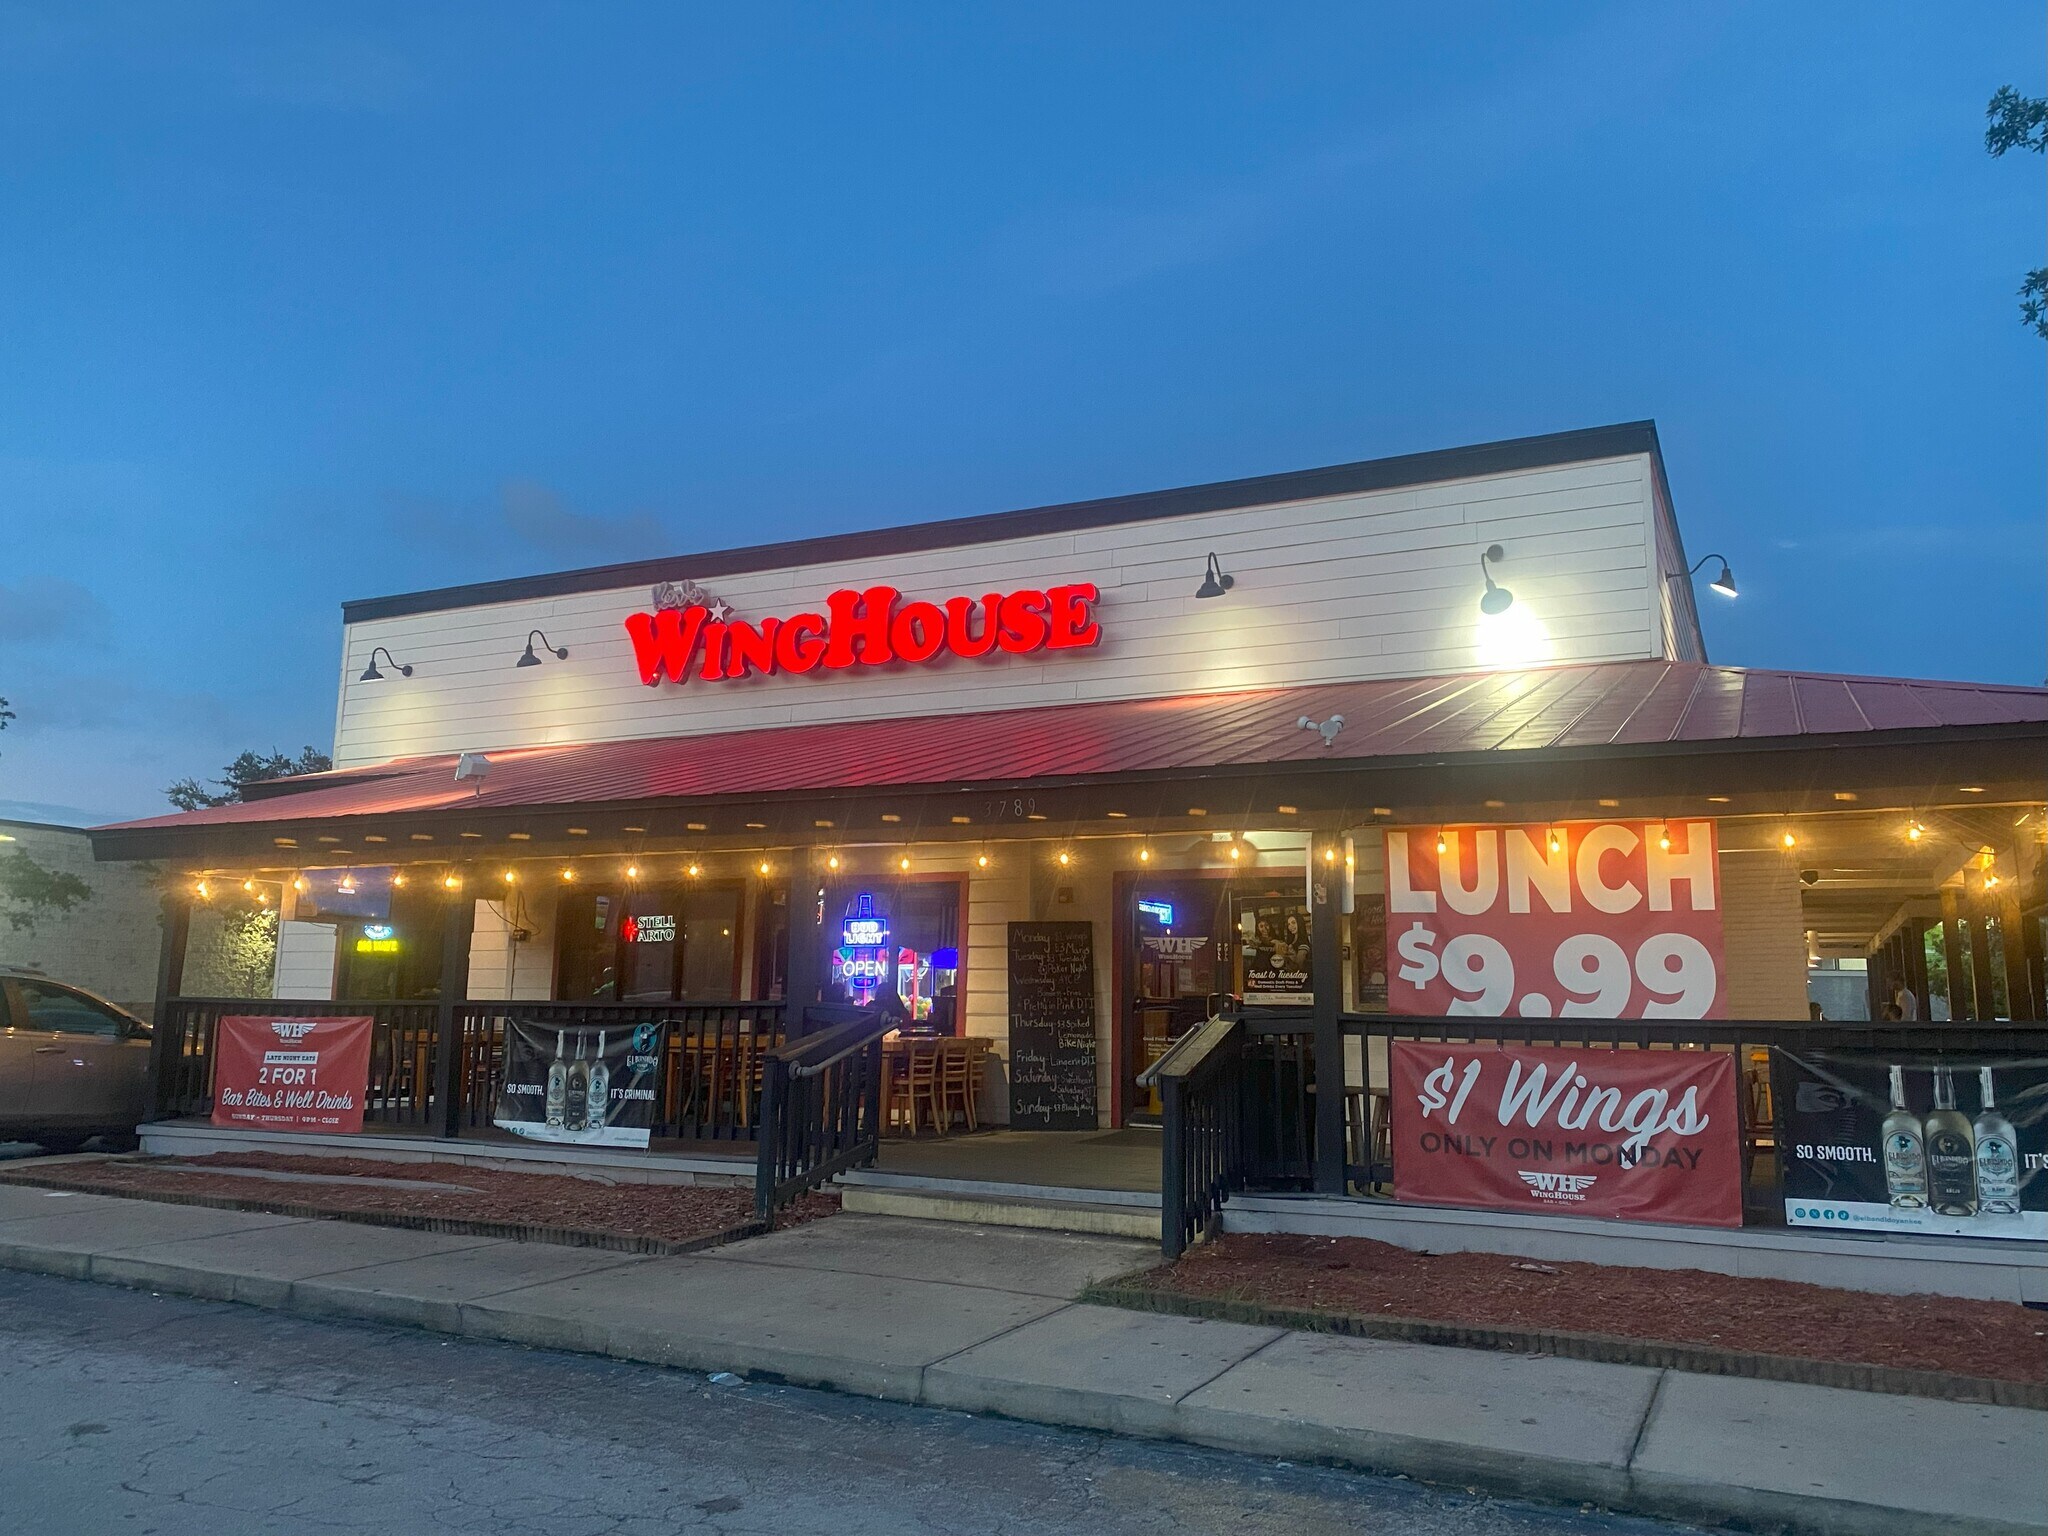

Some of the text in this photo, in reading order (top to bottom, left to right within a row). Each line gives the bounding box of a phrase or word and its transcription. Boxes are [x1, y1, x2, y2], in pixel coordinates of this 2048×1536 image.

[983, 797, 1036, 817] 3789
[1388, 822, 1716, 915] LUNCH
[637, 915, 676, 928] STELL
[850, 921, 878, 933] BUD
[637, 928, 676, 942] ARTO
[845, 932, 884, 944] LIGHT
[1013, 928, 1050, 953] Monday
[1157, 937, 1192, 953] WH
[842, 960, 886, 976] OPEN
[1248, 969, 1308, 983] Toast to Tuesday
[1397, 921, 1717, 1019] $9.99
[280, 1022, 303, 1037] WH
[1057, 1020, 1065, 1028] $3
[1066, 1016, 1090, 1030] Spiked
[1059, 1039, 1076, 1049] Bike
[258, 1067, 317, 1085] 2 FOR 1
[507, 1083, 516, 1094] SO
[610, 1088, 624, 1099] IT'S
[222, 1087, 354, 1110] Bar Bites & Well Drinks
[1054, 1104, 1061, 1112] $3
[1417, 1056, 1710, 1170] $1 Wings
[1420, 1131, 1703, 1171] ONLY ON MONDAY
[1796, 1144, 1877, 1164] SO SMOOTH,
[1535, 1173, 1578, 1192] WH
